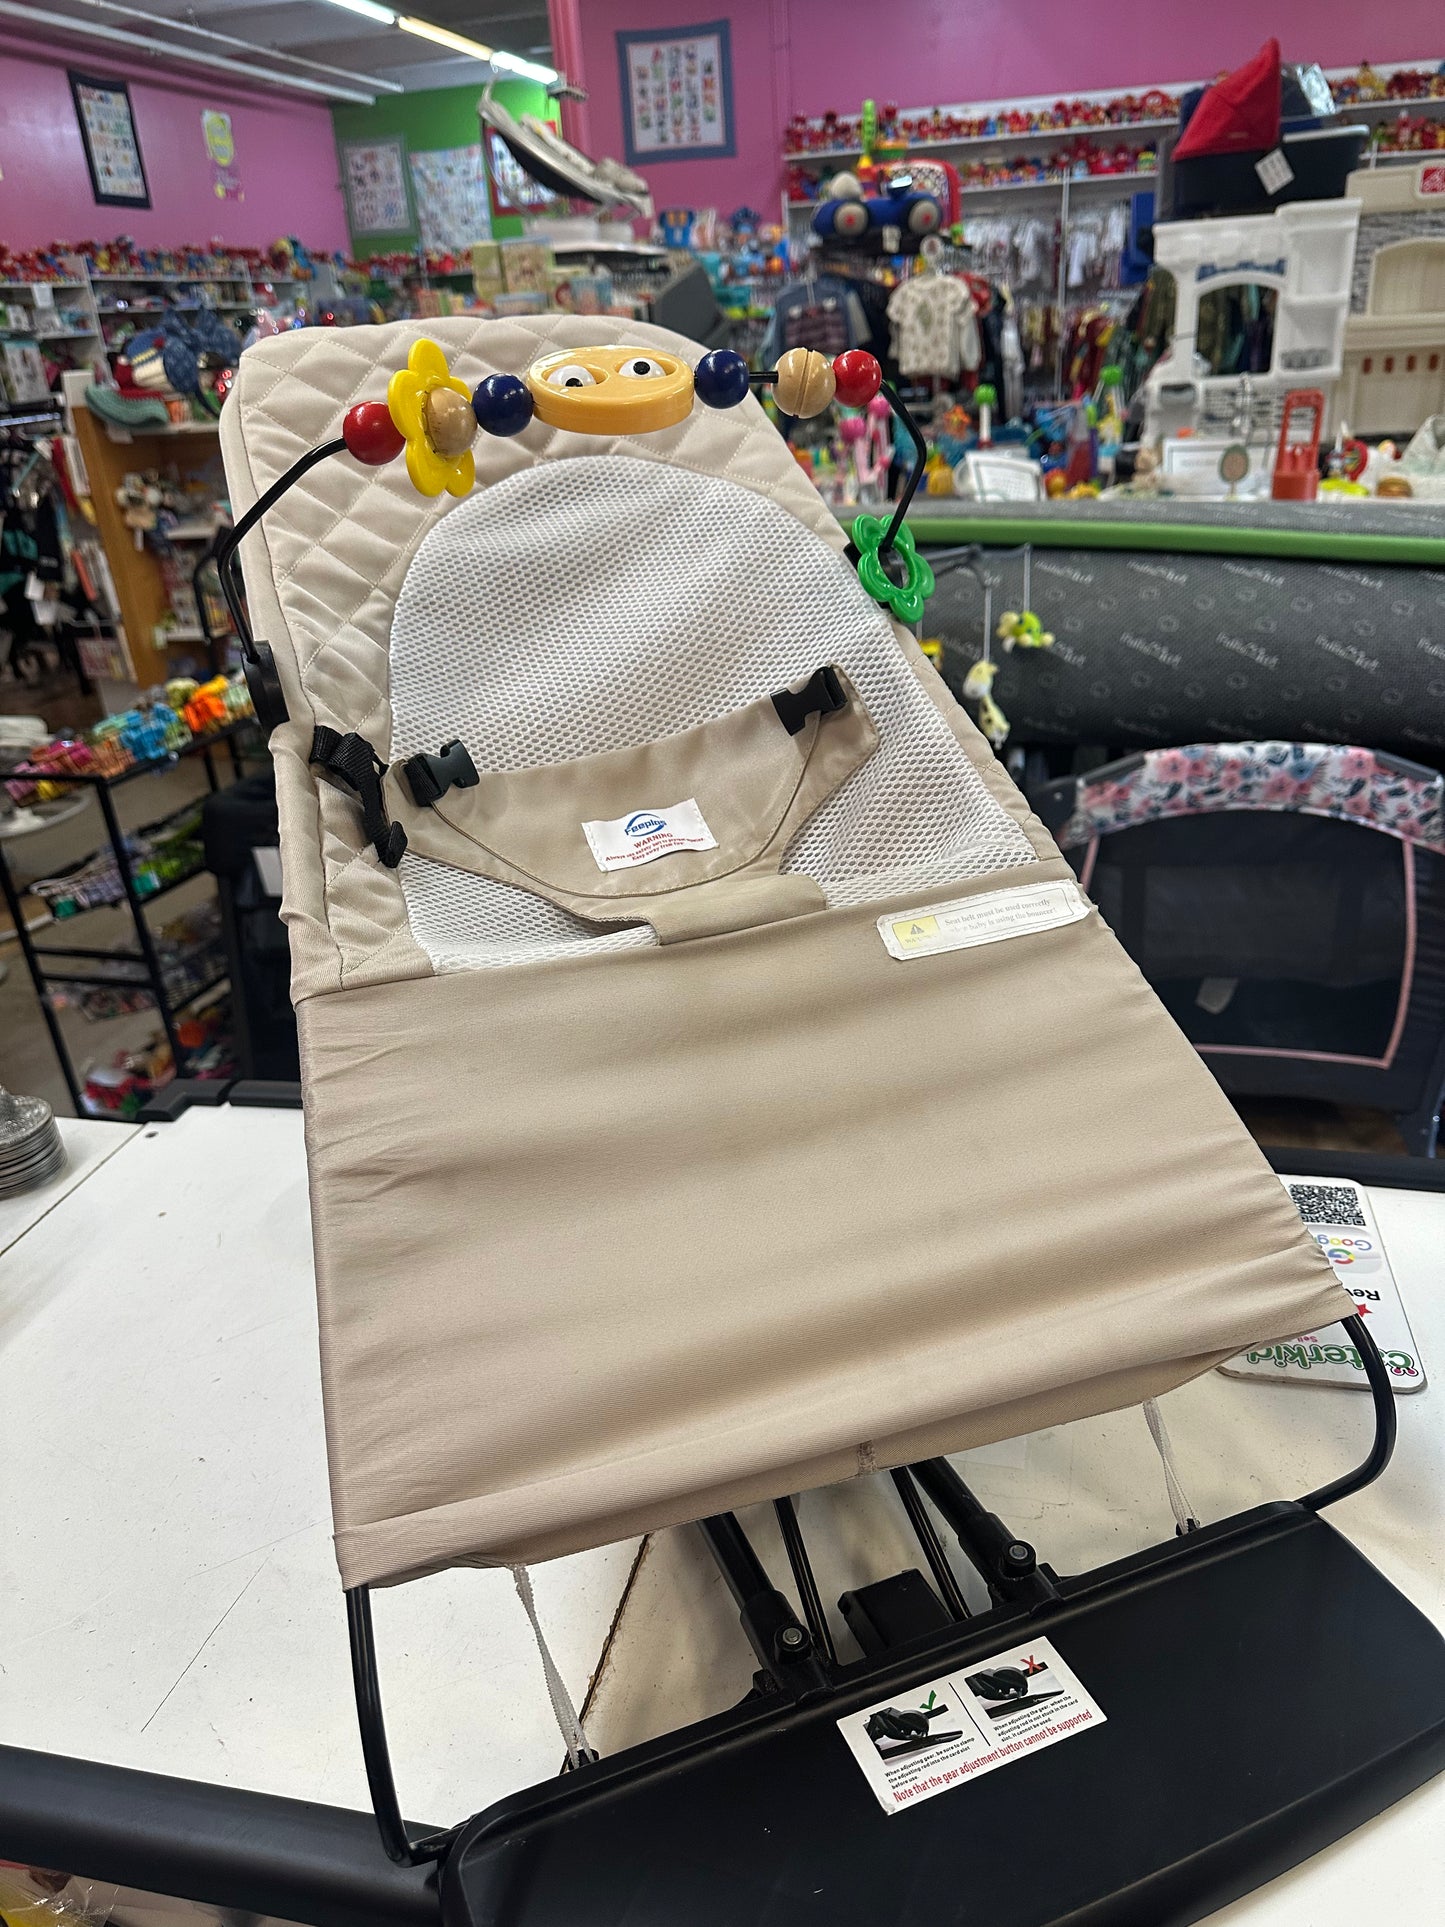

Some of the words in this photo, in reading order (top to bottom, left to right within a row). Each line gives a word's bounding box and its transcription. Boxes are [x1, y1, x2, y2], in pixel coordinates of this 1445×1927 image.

[634, 833, 674, 848] WARNING
[945, 917, 961, 926] Seat
[961, 914, 976, 922] belt
[976, 908, 994, 918] must
[1005, 903, 1020, 911] used
[1022, 899, 1050, 909] correctly
[994, 1723, 1008, 1731] When
[1008, 1713, 1030, 1725] adjusting
[1050, 1698, 1063, 1706] when
[998, 1725, 1020, 1736] adjusting
[884, 1769, 900, 1777] When
[900, 1759, 924, 1771] adjusting
[924, 1754, 936, 1762] gear,
[960, 1738, 974, 1746] clamp
[893, 1789, 914, 1802] Note
[913, 1781, 930, 1794] that
[929, 1776, 943, 1787] the
[942, 1769, 959, 1784] gear
[959, 1750, 1001, 1774] adjustment
[998, 1741, 1024, 1756] button
[1024, 1729, 1049, 1746] cannot
[1047, 1725, 1058, 1735] be
[1058, 1709, 1092, 1730] supported
[898, 1767, 921, 1779] adjusting
[892, 1780, 908, 1789] before
